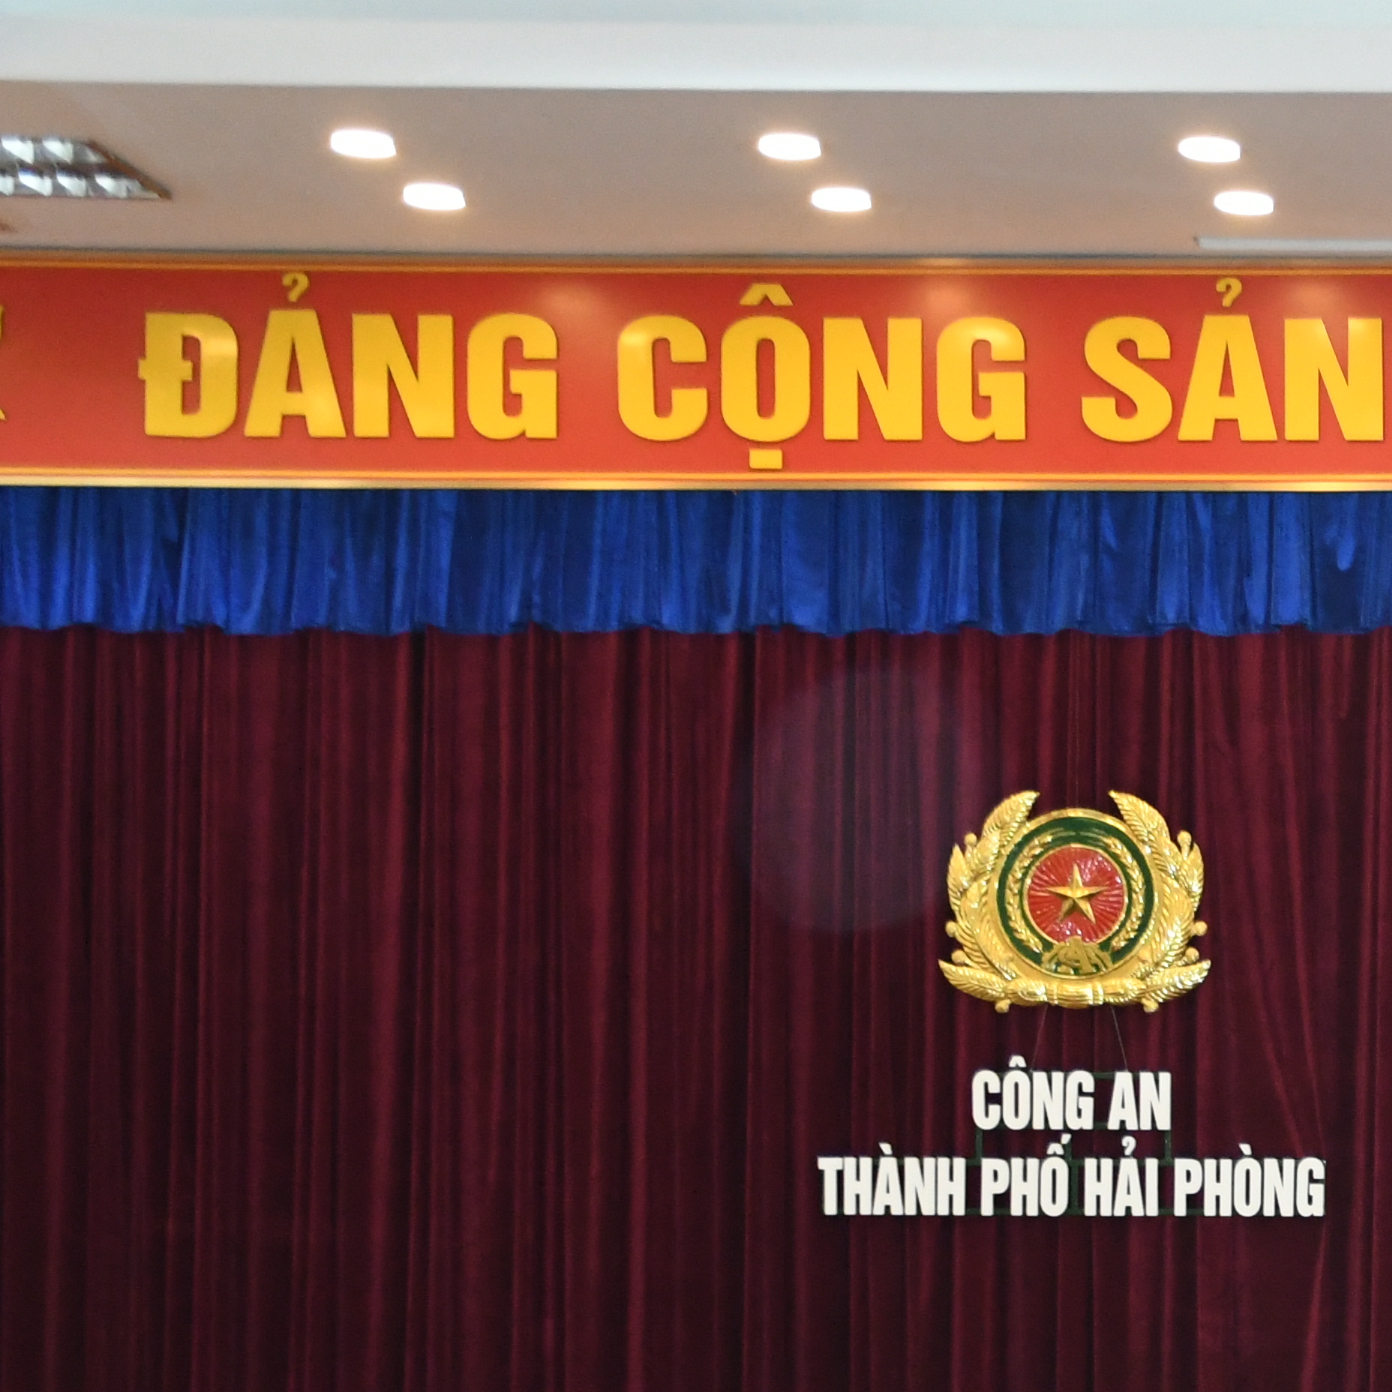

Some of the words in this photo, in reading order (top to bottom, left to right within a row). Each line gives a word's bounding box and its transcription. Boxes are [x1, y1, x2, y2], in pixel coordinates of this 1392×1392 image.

[137, 271, 559, 440] ĐẢNG
[617, 283, 1027, 470] CỘNG
[1081, 277, 1385, 442] SẢN
[971, 1055, 1095, 1131] CÔNG
[1107, 1070, 1172, 1131] AN
[817, 1142, 966, 1216] THÀNH
[980, 1133, 1072, 1217] PHỐ
[1083, 1135, 1159, 1217] HẢI
[1173, 1143, 1326, 1218] PHÒNG
